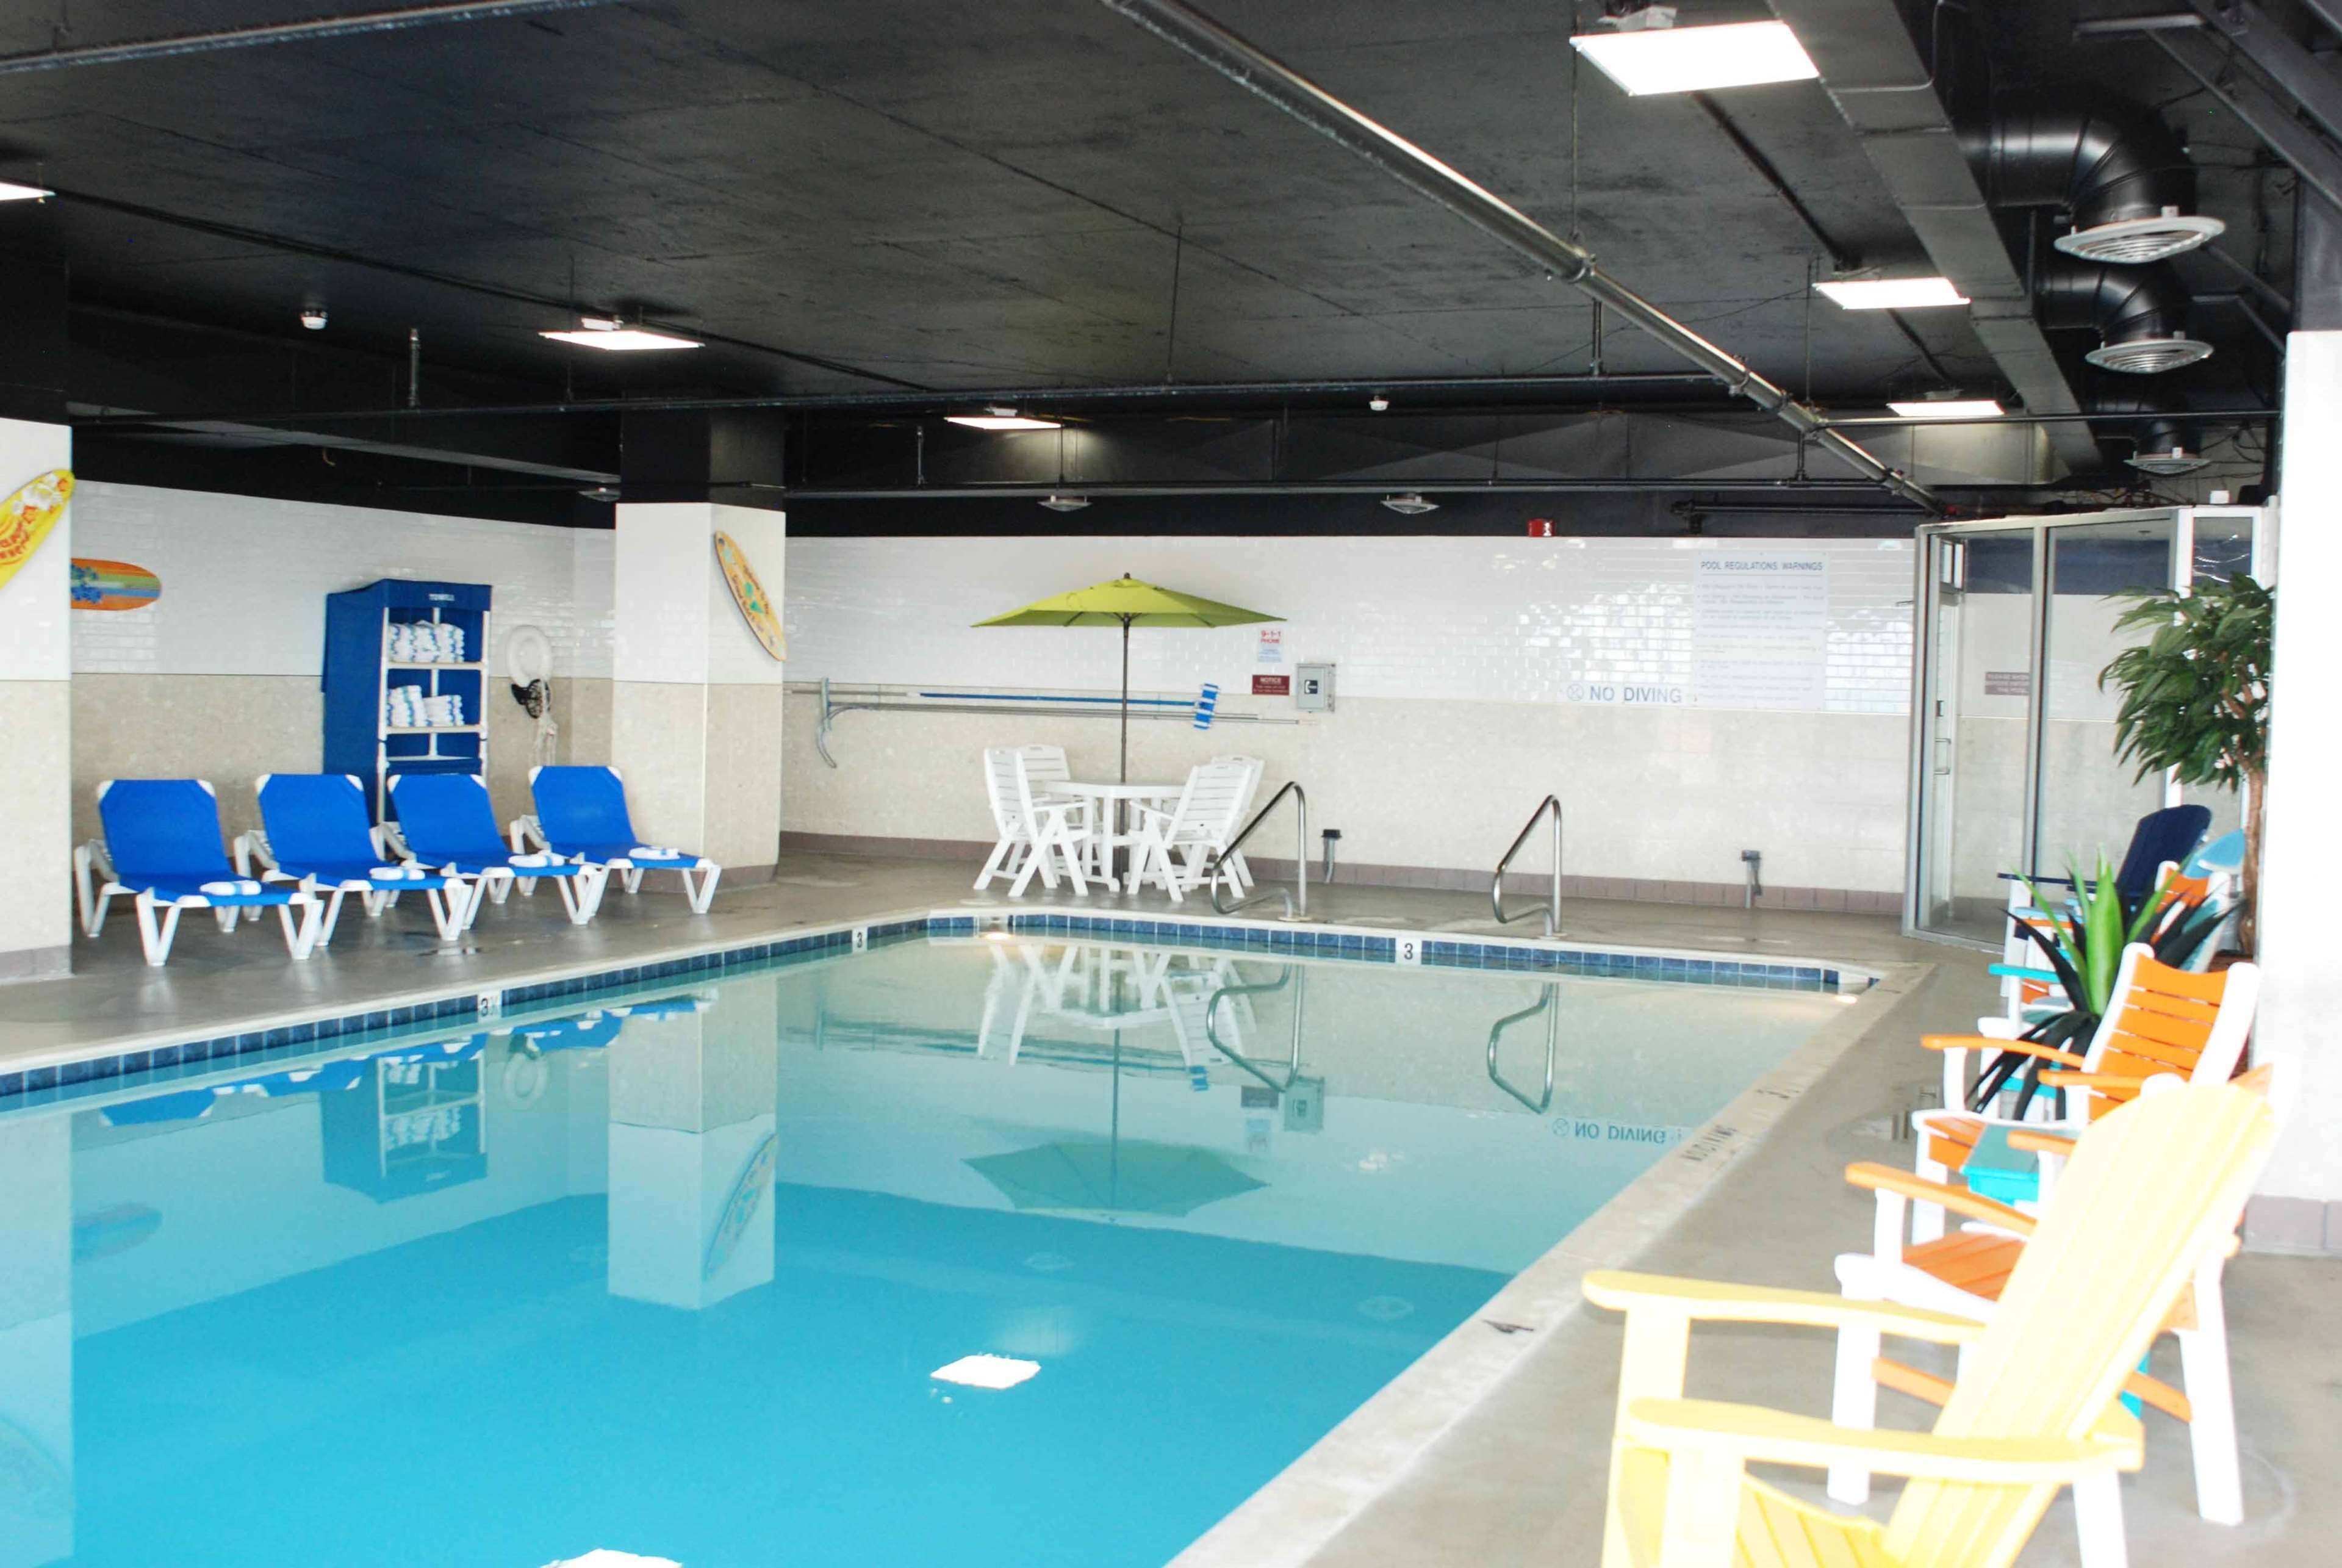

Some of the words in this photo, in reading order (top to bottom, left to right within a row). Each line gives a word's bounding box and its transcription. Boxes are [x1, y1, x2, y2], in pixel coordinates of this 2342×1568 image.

[1701, 561, 1722, 570] POOL
[1590, 686, 1614, 701] NO
[1624, 687, 1681, 703] DIVING
[1404, 942, 1413, 960] 3
